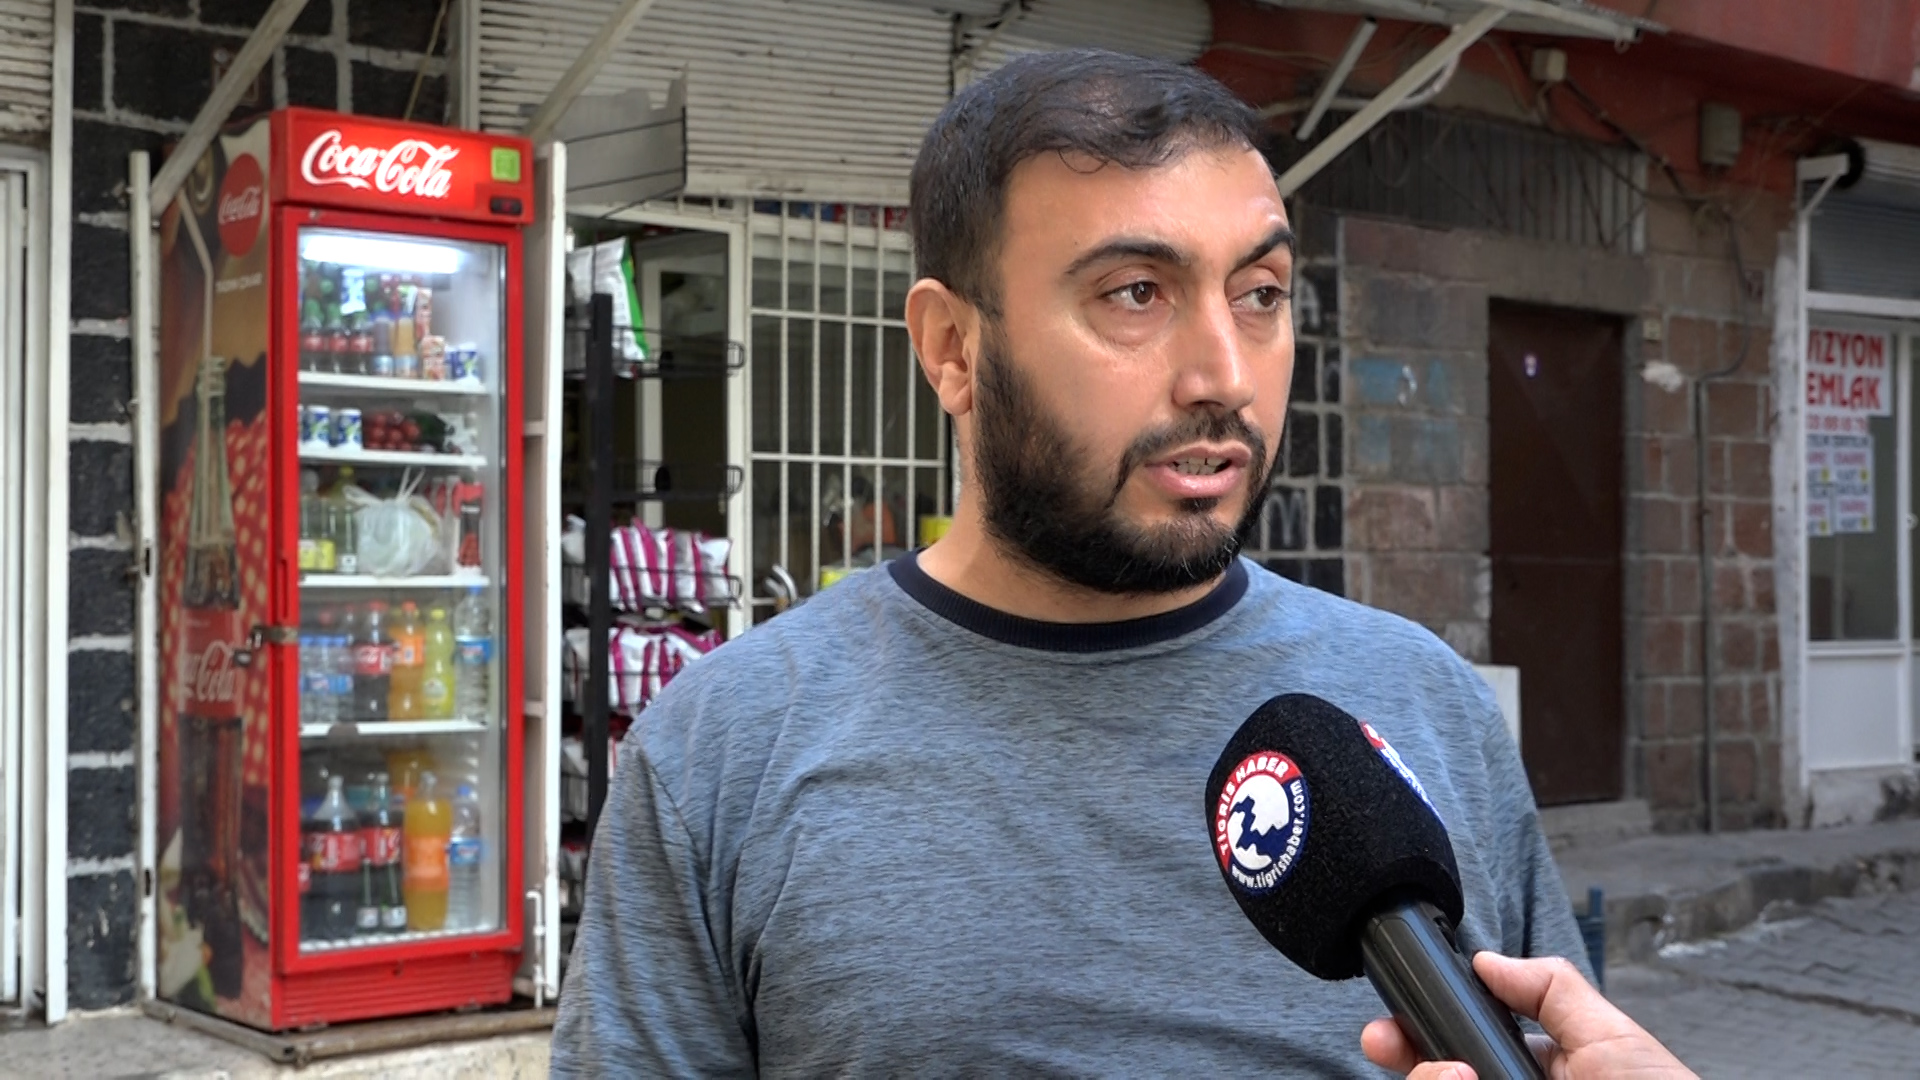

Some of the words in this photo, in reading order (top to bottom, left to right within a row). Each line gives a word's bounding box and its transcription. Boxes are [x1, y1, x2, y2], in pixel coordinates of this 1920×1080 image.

[301, 129, 460, 198] Coca-Cola
[1807, 372, 1881, 411] EMLAK
[1236, 755, 1289, 783] HABER
[1231, 779, 1306, 889] www.tigrishaber.com
